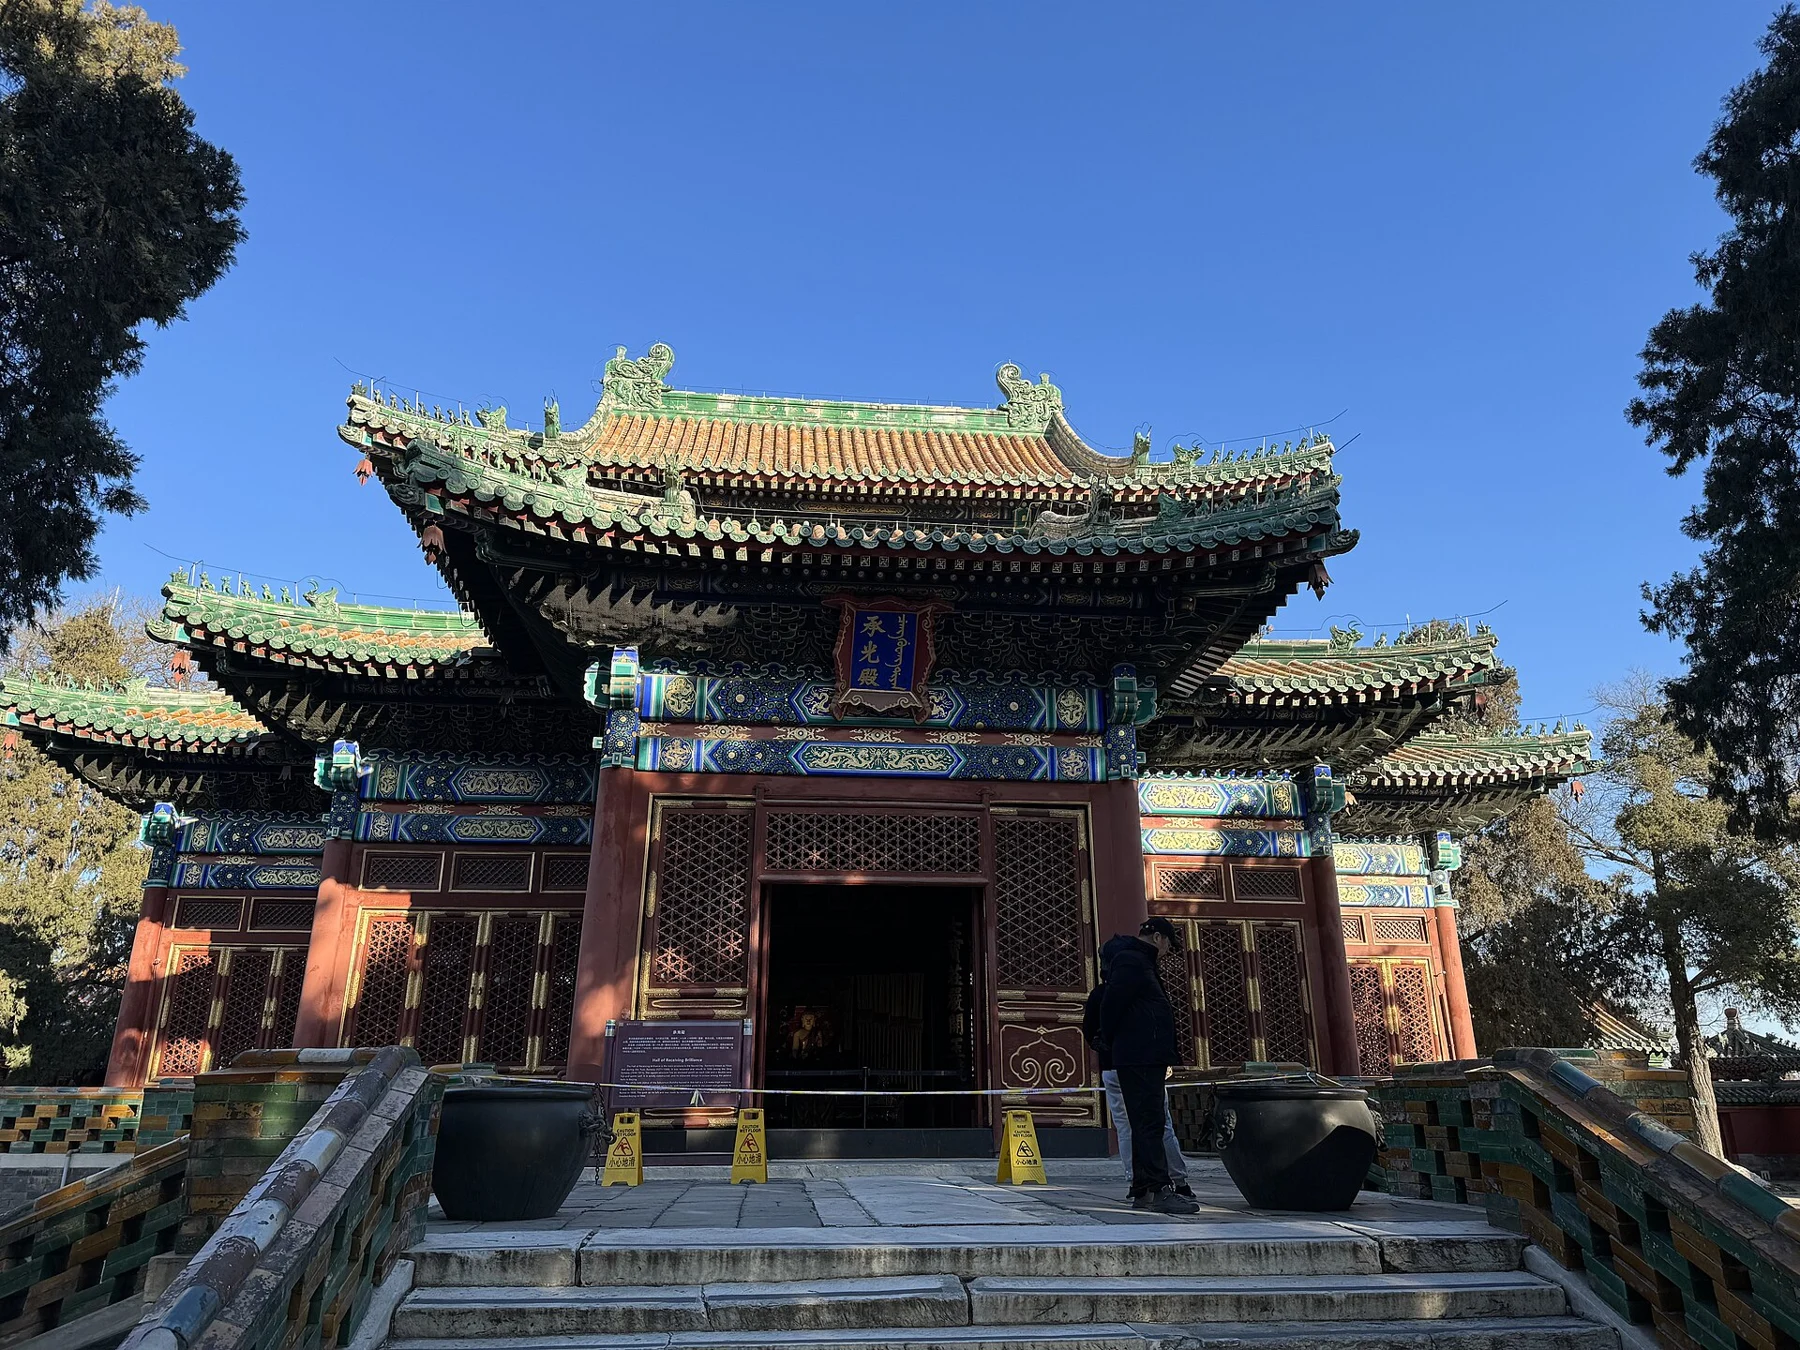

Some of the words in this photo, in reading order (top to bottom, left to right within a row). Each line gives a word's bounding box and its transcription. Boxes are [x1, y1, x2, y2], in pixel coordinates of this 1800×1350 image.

[858, 616, 886, 687] 承光殿
[609, 1156, 636, 1168] 小心地滑
[737, 1153, 762, 1164] 小心地滑
